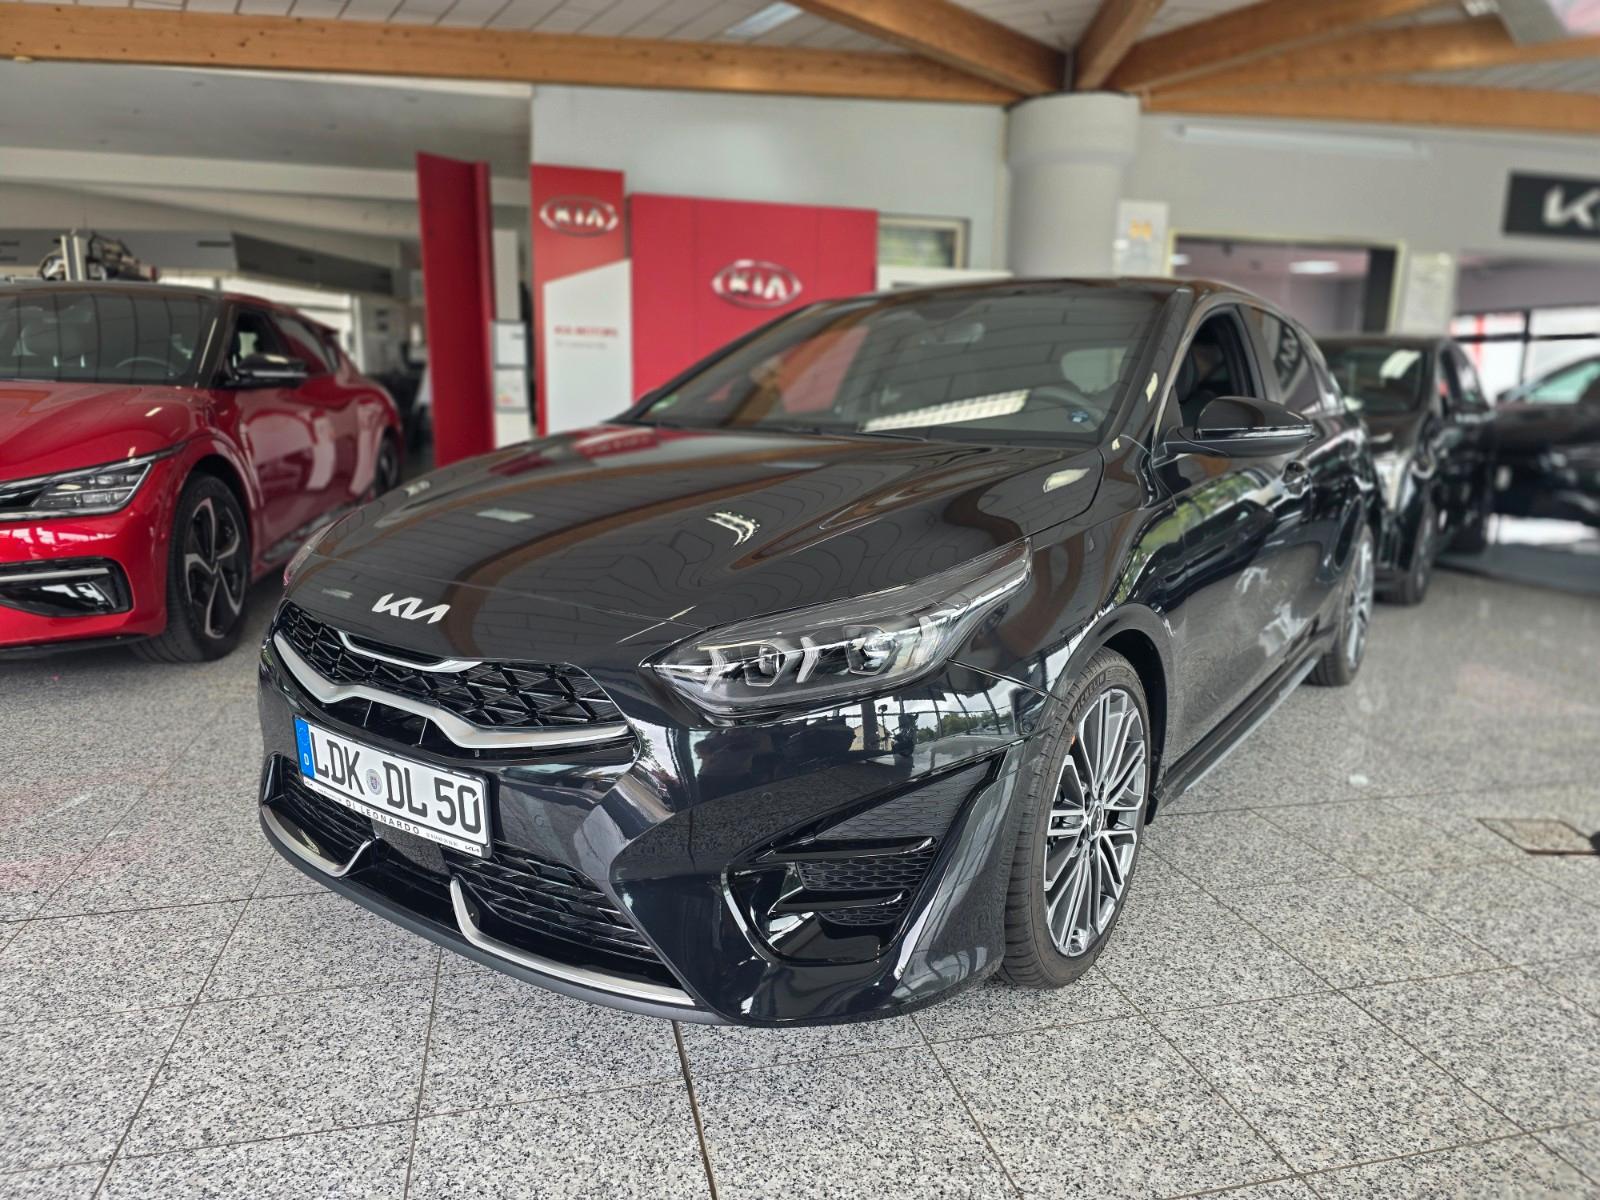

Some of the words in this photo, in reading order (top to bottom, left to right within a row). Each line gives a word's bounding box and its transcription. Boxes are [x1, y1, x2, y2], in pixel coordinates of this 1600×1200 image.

[554, 206, 605, 229] KIA
[1544, 186, 1600, 229] K
[728, 271, 788, 300] KIA
[371, 593, 451, 624] KIA
[1071, 671, 1106, 721] MICHELIN
[310, 731, 365, 795] LDK
[382, 760, 428, 818] DL
[434, 776, 482, 834] 50
[345, 799, 356, 810] DI
[360, 806, 420, 835] LEONARDO
